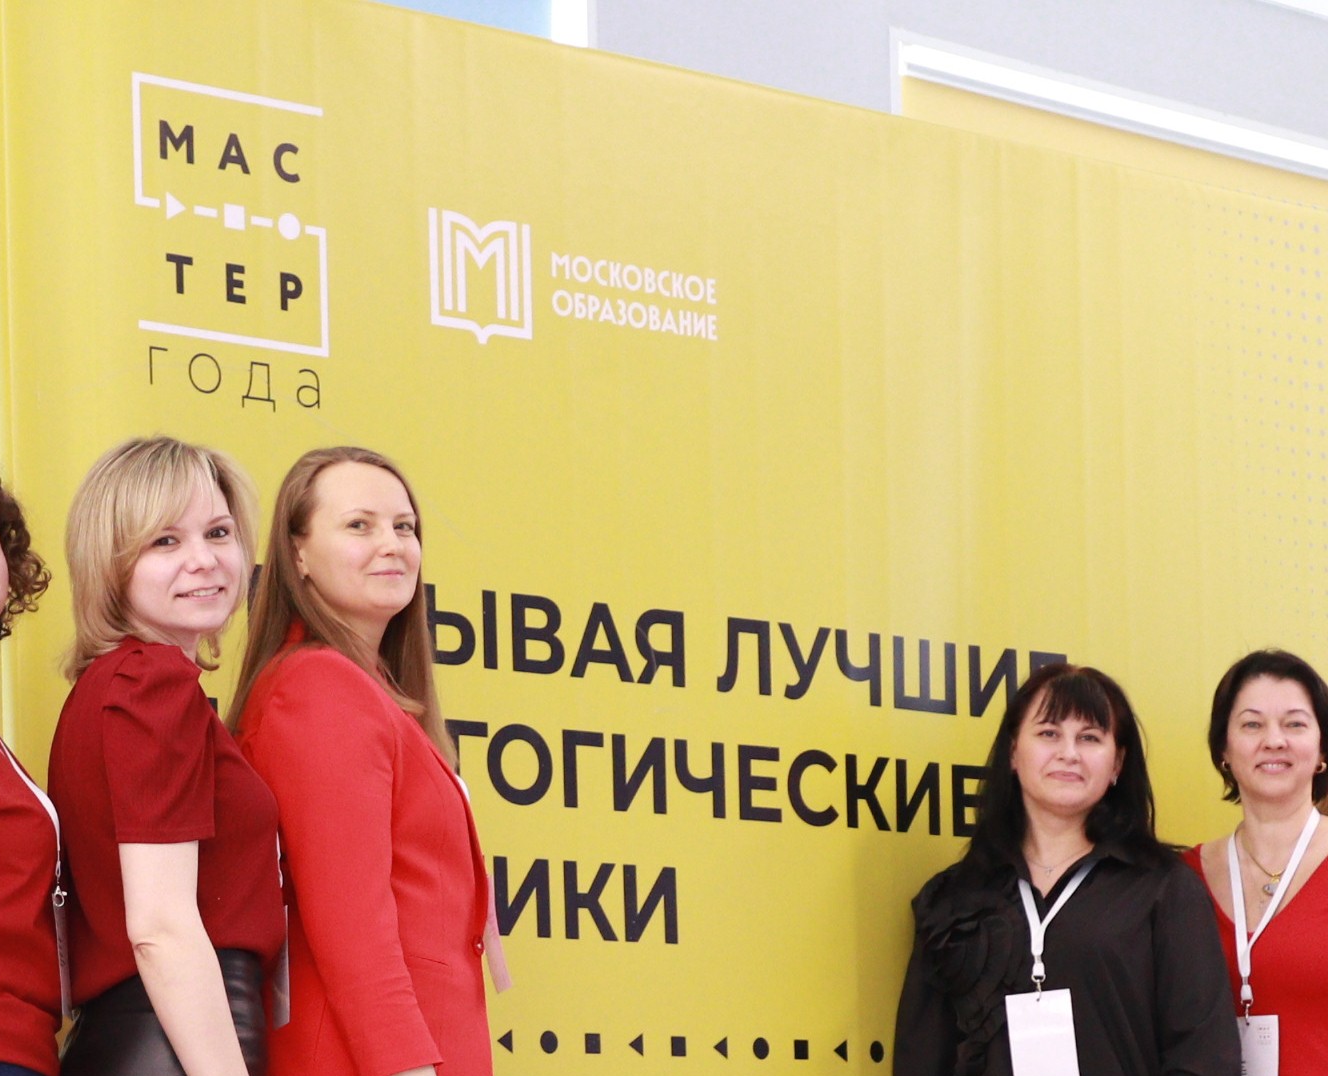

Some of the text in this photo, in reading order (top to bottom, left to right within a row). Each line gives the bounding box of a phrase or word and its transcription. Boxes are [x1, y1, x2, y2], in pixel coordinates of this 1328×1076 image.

[159, 119, 301, 184] МАС
[165, 253, 304, 312] ТЕР
[551, 252, 717, 305] МОСКОВСКОЕ
[552, 289, 718, 341] ОБРАЗОВАНИЕ
[148, 345, 322, 413] года
[716, 616, 1067, 718] ЛУЧШИ
